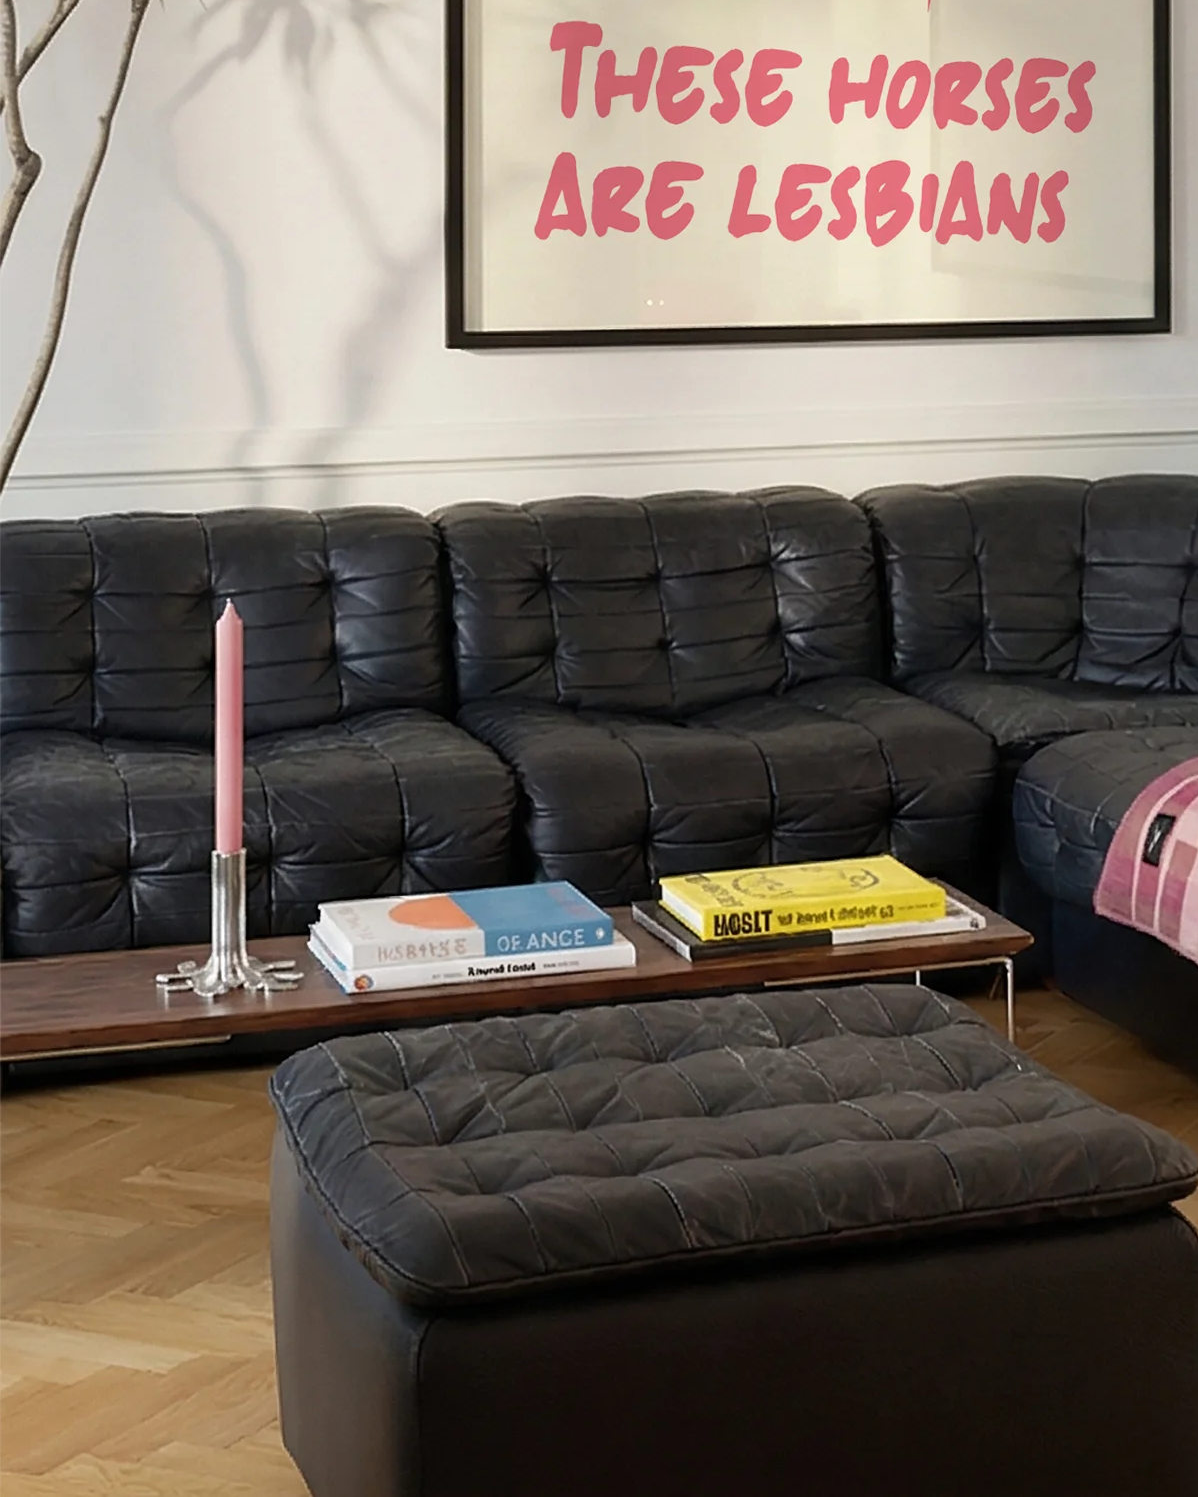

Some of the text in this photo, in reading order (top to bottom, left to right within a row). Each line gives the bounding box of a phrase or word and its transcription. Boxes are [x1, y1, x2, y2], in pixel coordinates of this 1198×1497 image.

[550, 21, 1097, 134] THESE HORSES
[535, 152, 1069, 247] ARE LESBIANS
